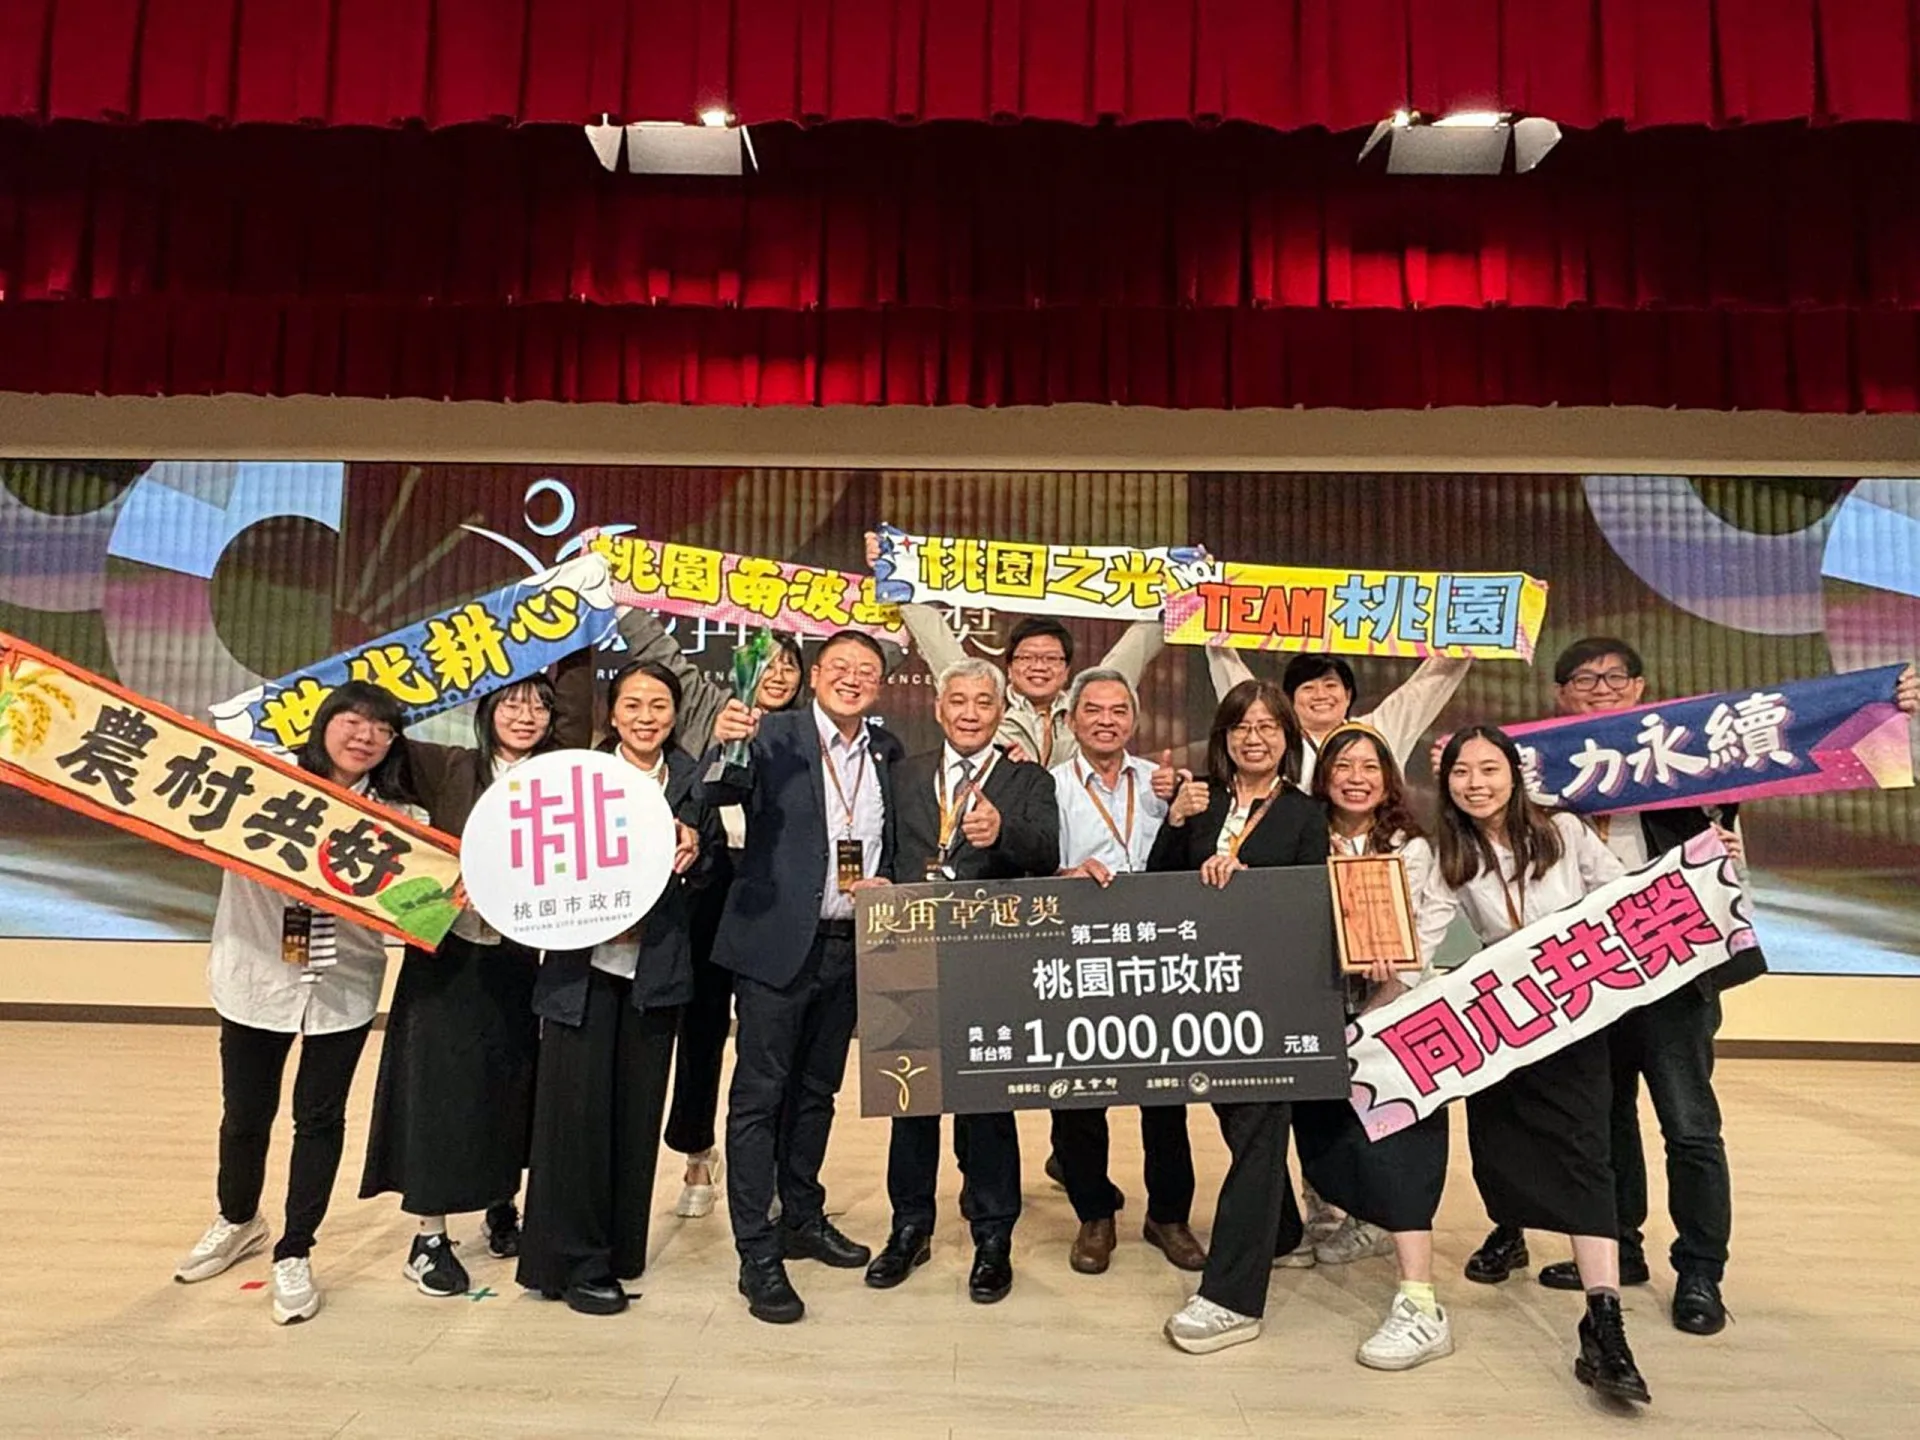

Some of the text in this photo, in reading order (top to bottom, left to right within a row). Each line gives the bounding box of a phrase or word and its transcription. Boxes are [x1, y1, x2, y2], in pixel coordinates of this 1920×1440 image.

[919, 536, 1166, 609] 桃園之光
[1197, 574, 1524, 648] TEAM 桃園
[259, 586, 581, 749] 世代耕心
[56, 704, 413, 897] 農村共好
[513, 889, 632, 922] 桃園市政府
[1071, 922, 1132, 946] 第二組
[1136, 919, 1198, 943] 第一名
[1032, 951, 1243, 1001] 桃園市政府
[1375, 869, 1723, 1097] 同心共榮
[1024, 1010, 1264, 1069] 1,000,000
[1284, 1034, 1320, 1054] 元整
